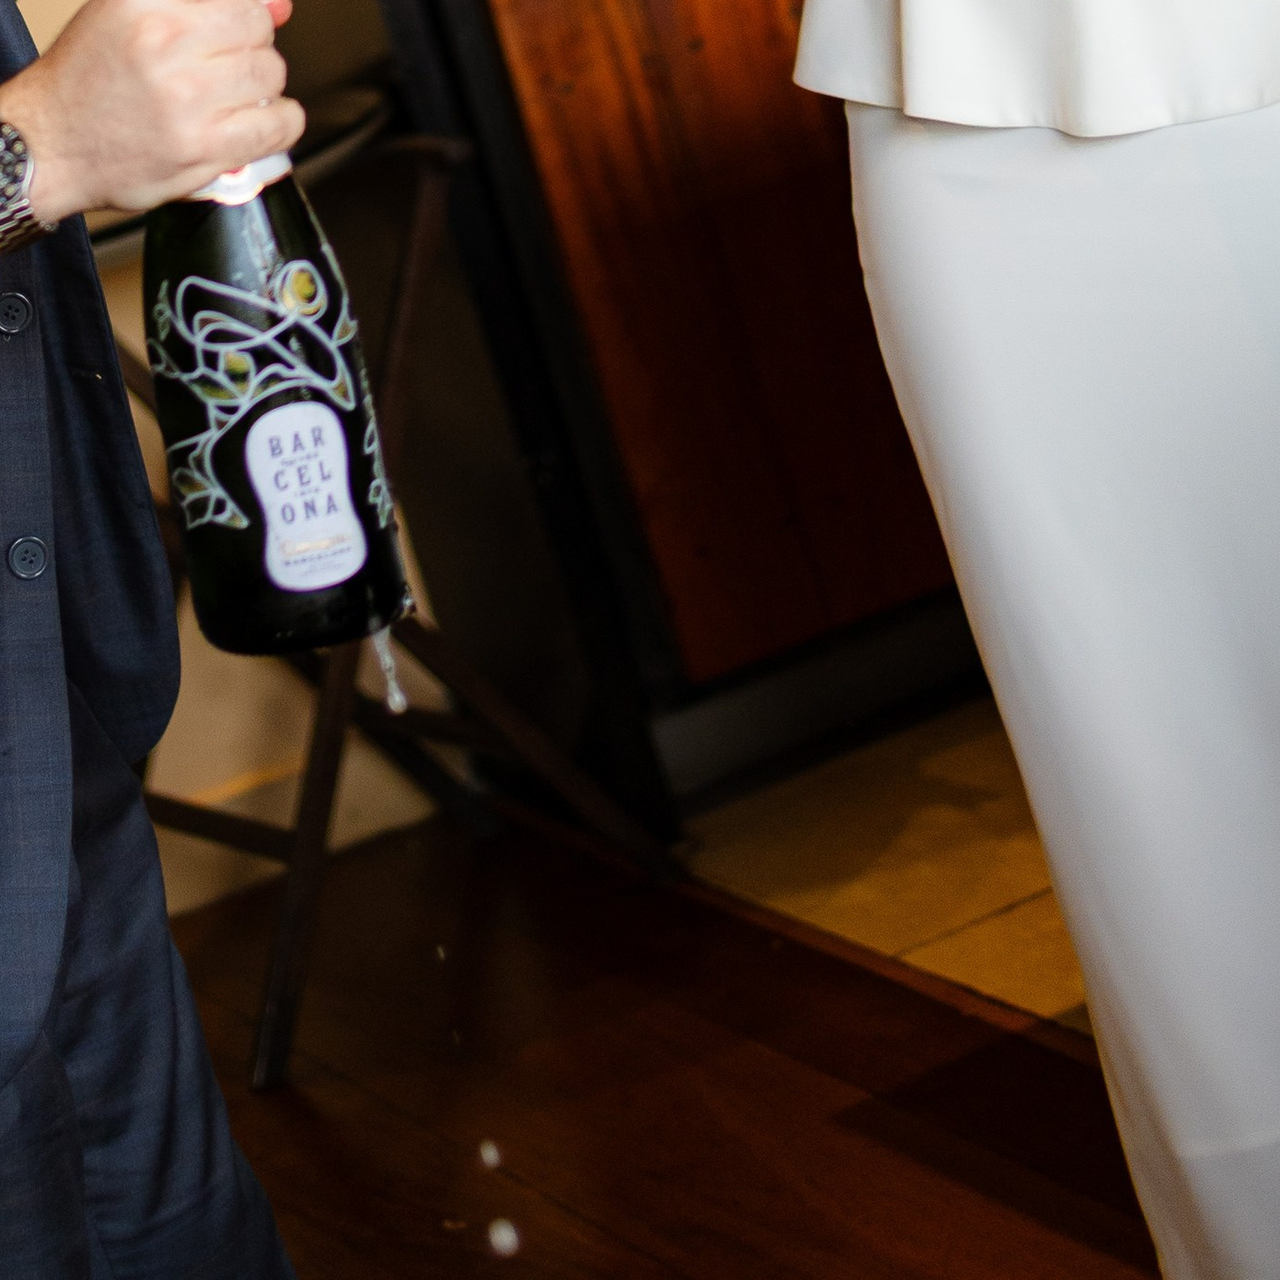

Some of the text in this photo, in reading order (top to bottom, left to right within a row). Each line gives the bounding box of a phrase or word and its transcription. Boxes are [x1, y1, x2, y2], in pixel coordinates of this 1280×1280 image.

[268, 425, 325, 457] BAR
[274, 460, 331, 491] CEL
[281, 493, 338, 524] ONA
